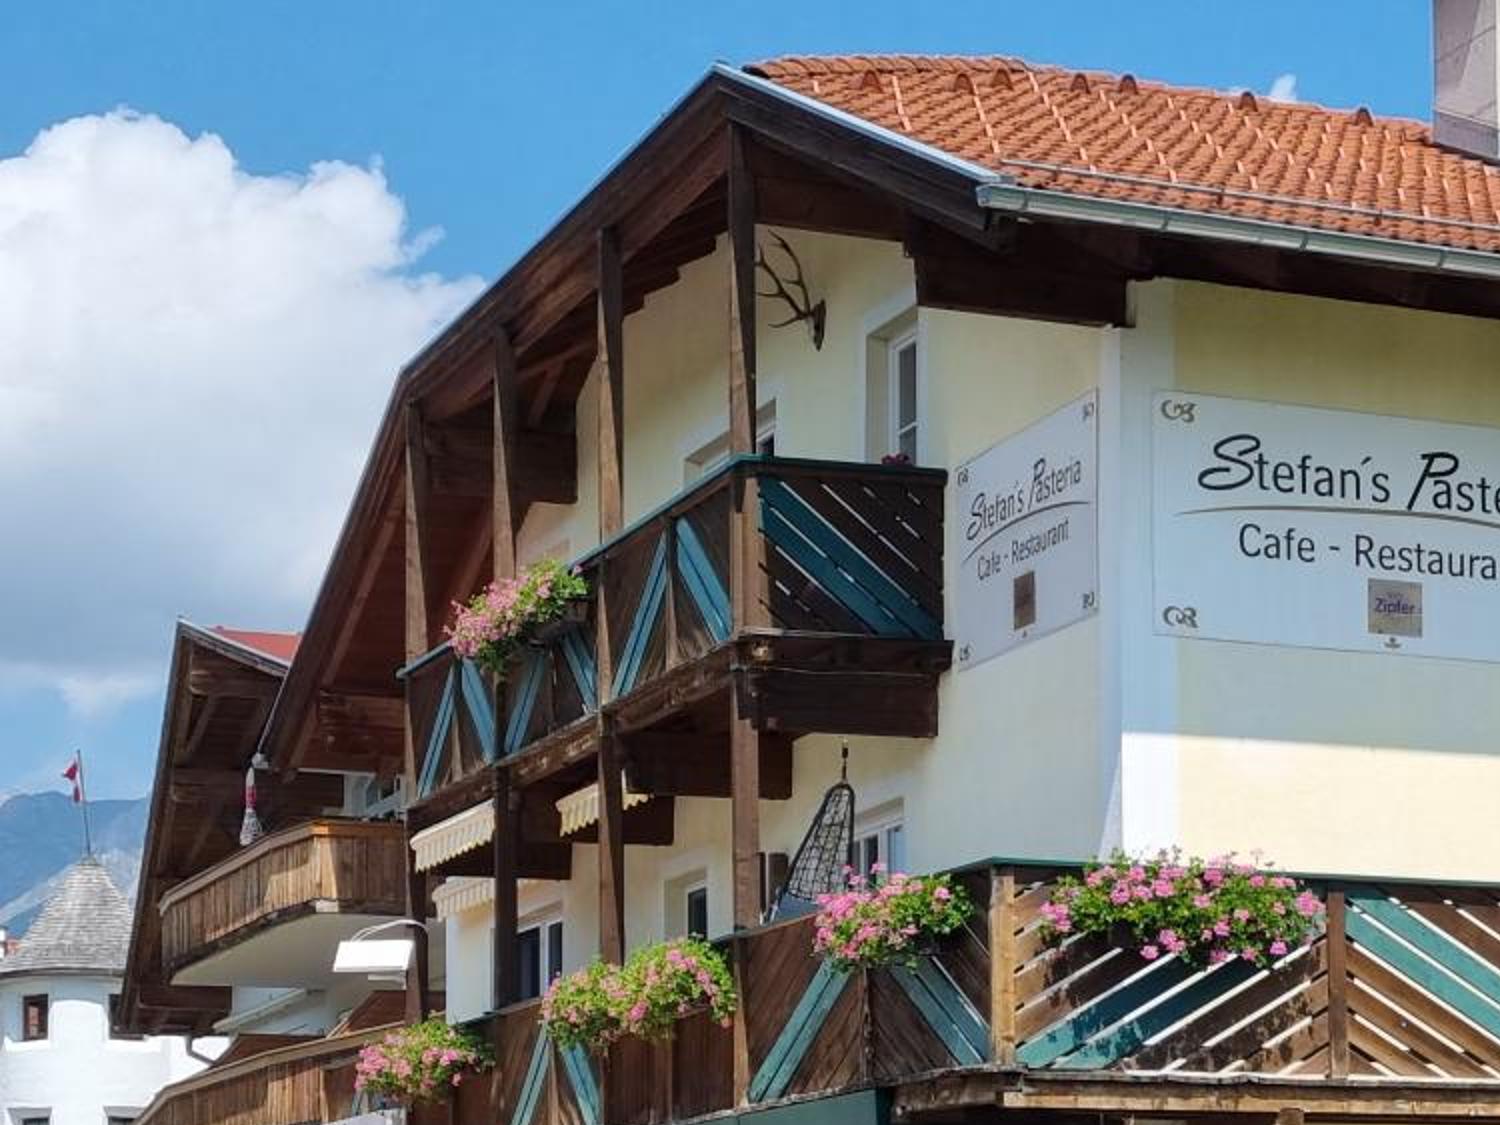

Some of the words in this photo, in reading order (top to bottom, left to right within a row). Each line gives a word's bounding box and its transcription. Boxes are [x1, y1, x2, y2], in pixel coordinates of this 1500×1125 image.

[1028, 458, 1081, 511] Pasteria
[976, 553, 1001, 580] Cafe
[1011, 516, 1069, 565] Restaurant
[1238, 523, 1316, 562] Cafe
[1374, 597, 1417, 616] Zipfer
